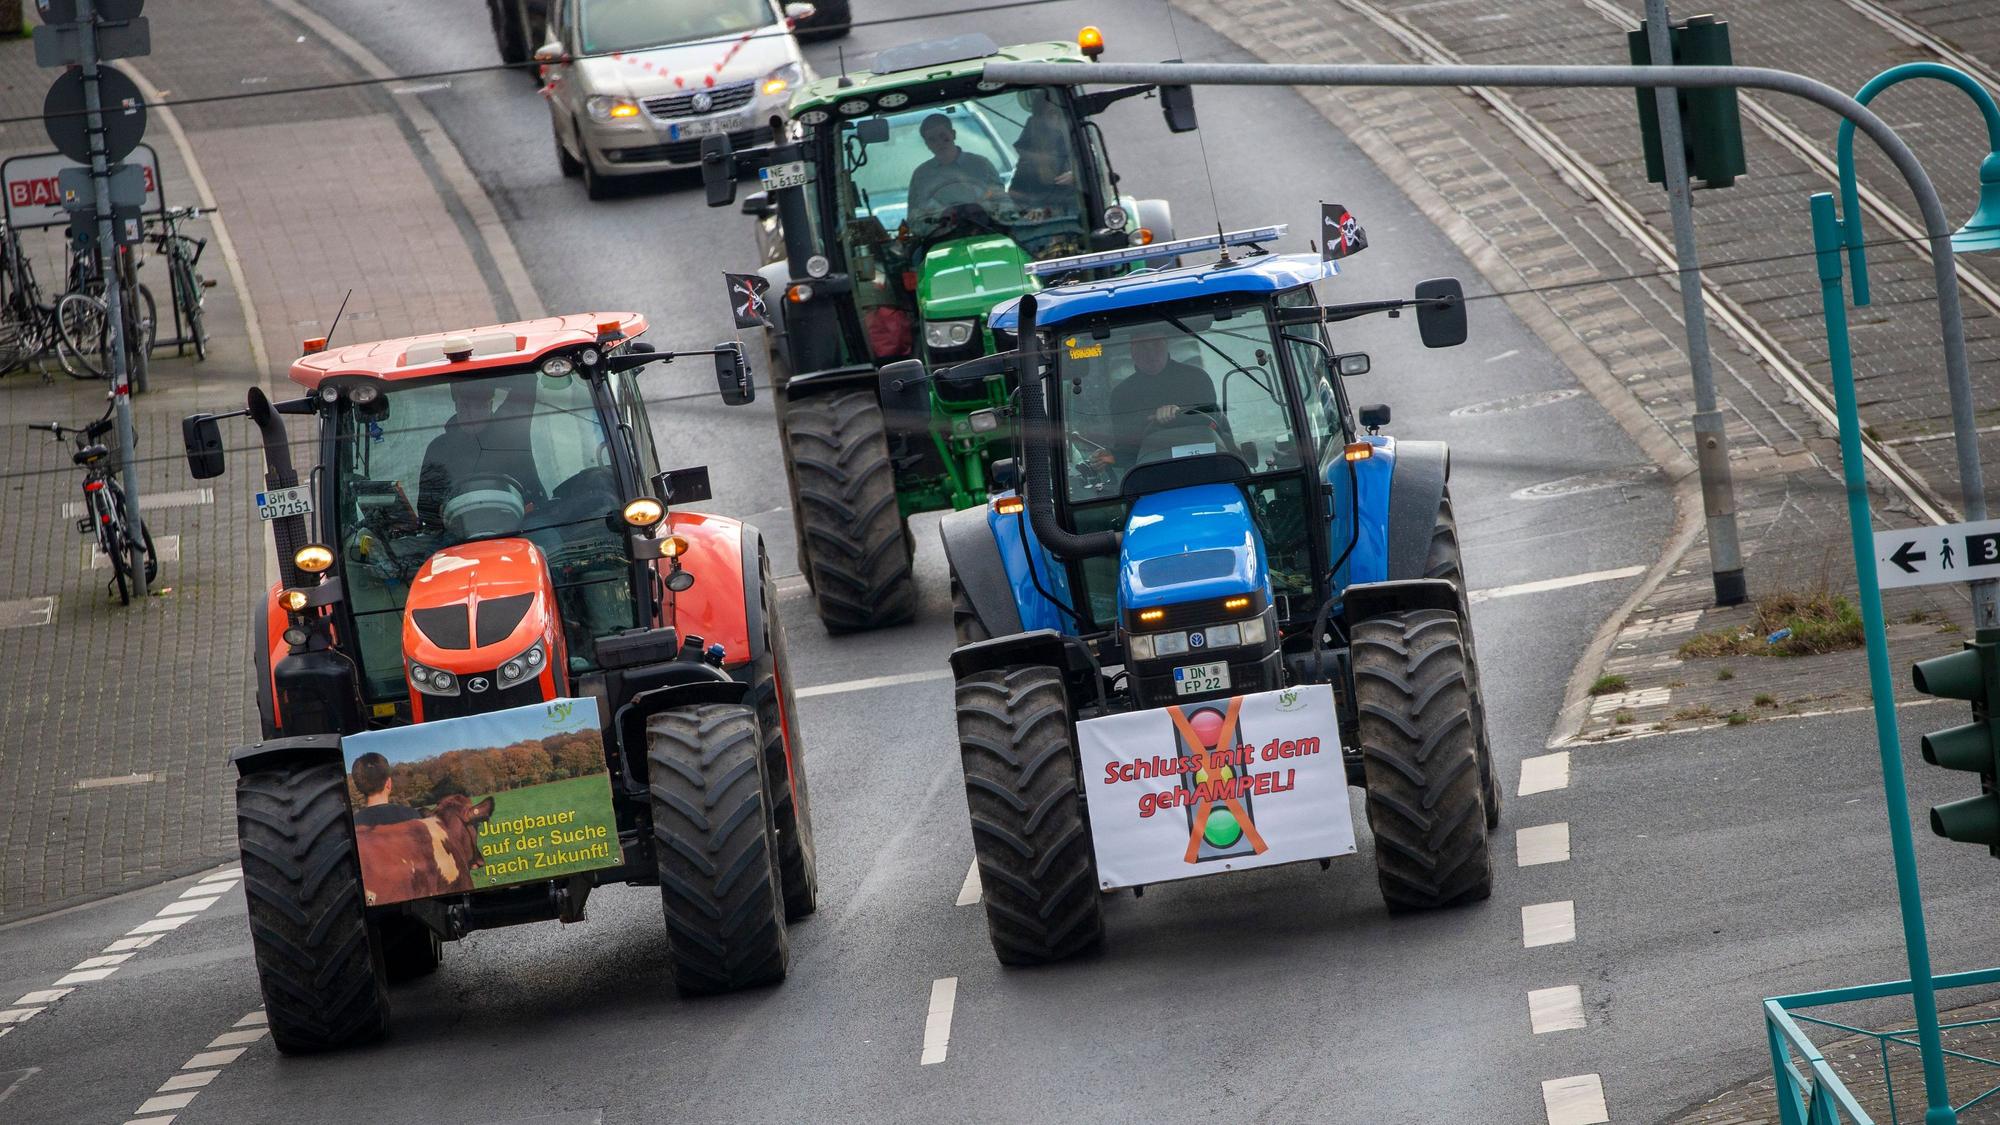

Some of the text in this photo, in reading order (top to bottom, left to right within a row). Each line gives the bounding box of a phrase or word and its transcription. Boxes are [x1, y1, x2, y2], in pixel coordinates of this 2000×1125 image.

[770, 166, 784, 178] NE
[260, 500, 312, 519] CD 7151
[269, 492, 286, 505] BM
[1983, 538, 1999, 560] 3
[1190, 666, 1206, 679] DN
[1184, 677, 1221, 693] FP 22
[1104, 736, 1320, 785] Schluss mit dem
[1138, 768, 1296, 818] gehAMPEL!
[479, 809, 576, 837] Jungbauer
[482, 825, 607, 857] auf der Suche
[485, 841, 609, 876] nach Zukunft!
